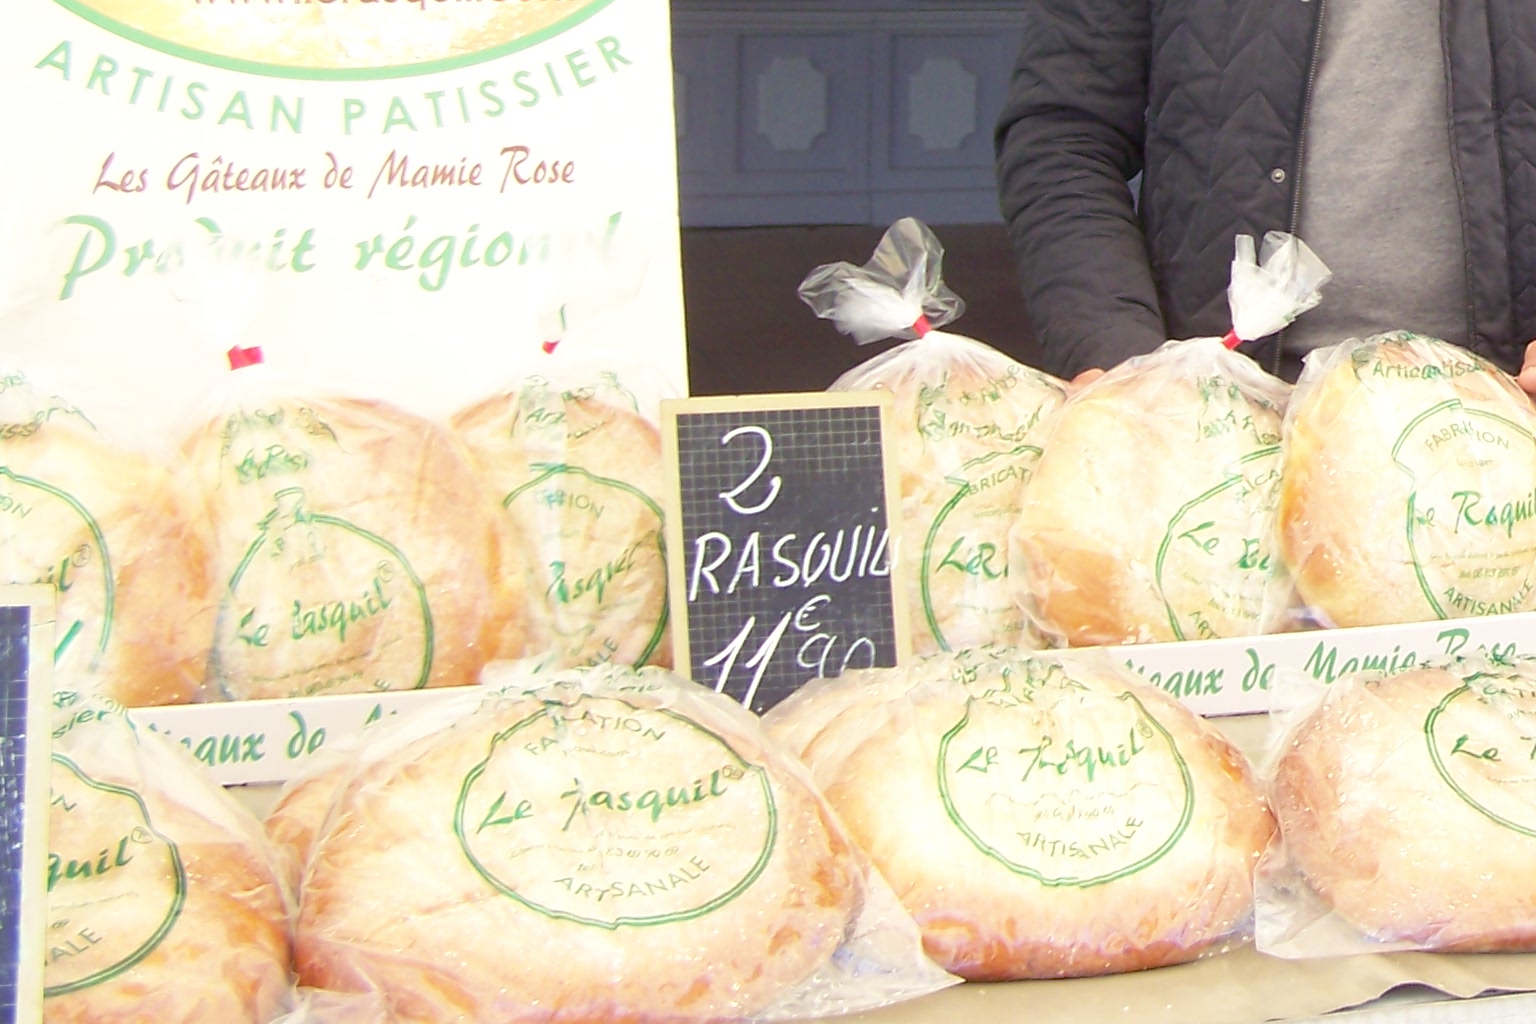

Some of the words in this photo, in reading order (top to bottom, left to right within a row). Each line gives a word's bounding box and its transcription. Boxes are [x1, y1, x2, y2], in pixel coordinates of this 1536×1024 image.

[35, 39, 304, 135] ARTISAN
[342, 34, 634, 136] PATISSIER
[91, 150, 149, 197] Les
[166, 150, 306, 205] Gâteaux
[322, 150, 355, 190] de
[367, 148, 483, 199] Mamie
[498, 144, 576, 194] Rose
[58, 214, 316, 302] Prit
[354, 211, 623, 292] régionl
[718, 425, 782, 515] 2
[1241, 648, 1276, 693] de
[476, 791, 534, 834] Le
[46, 835, 134, 893] quil
[554, 855, 711, 903] ARTSANALE
